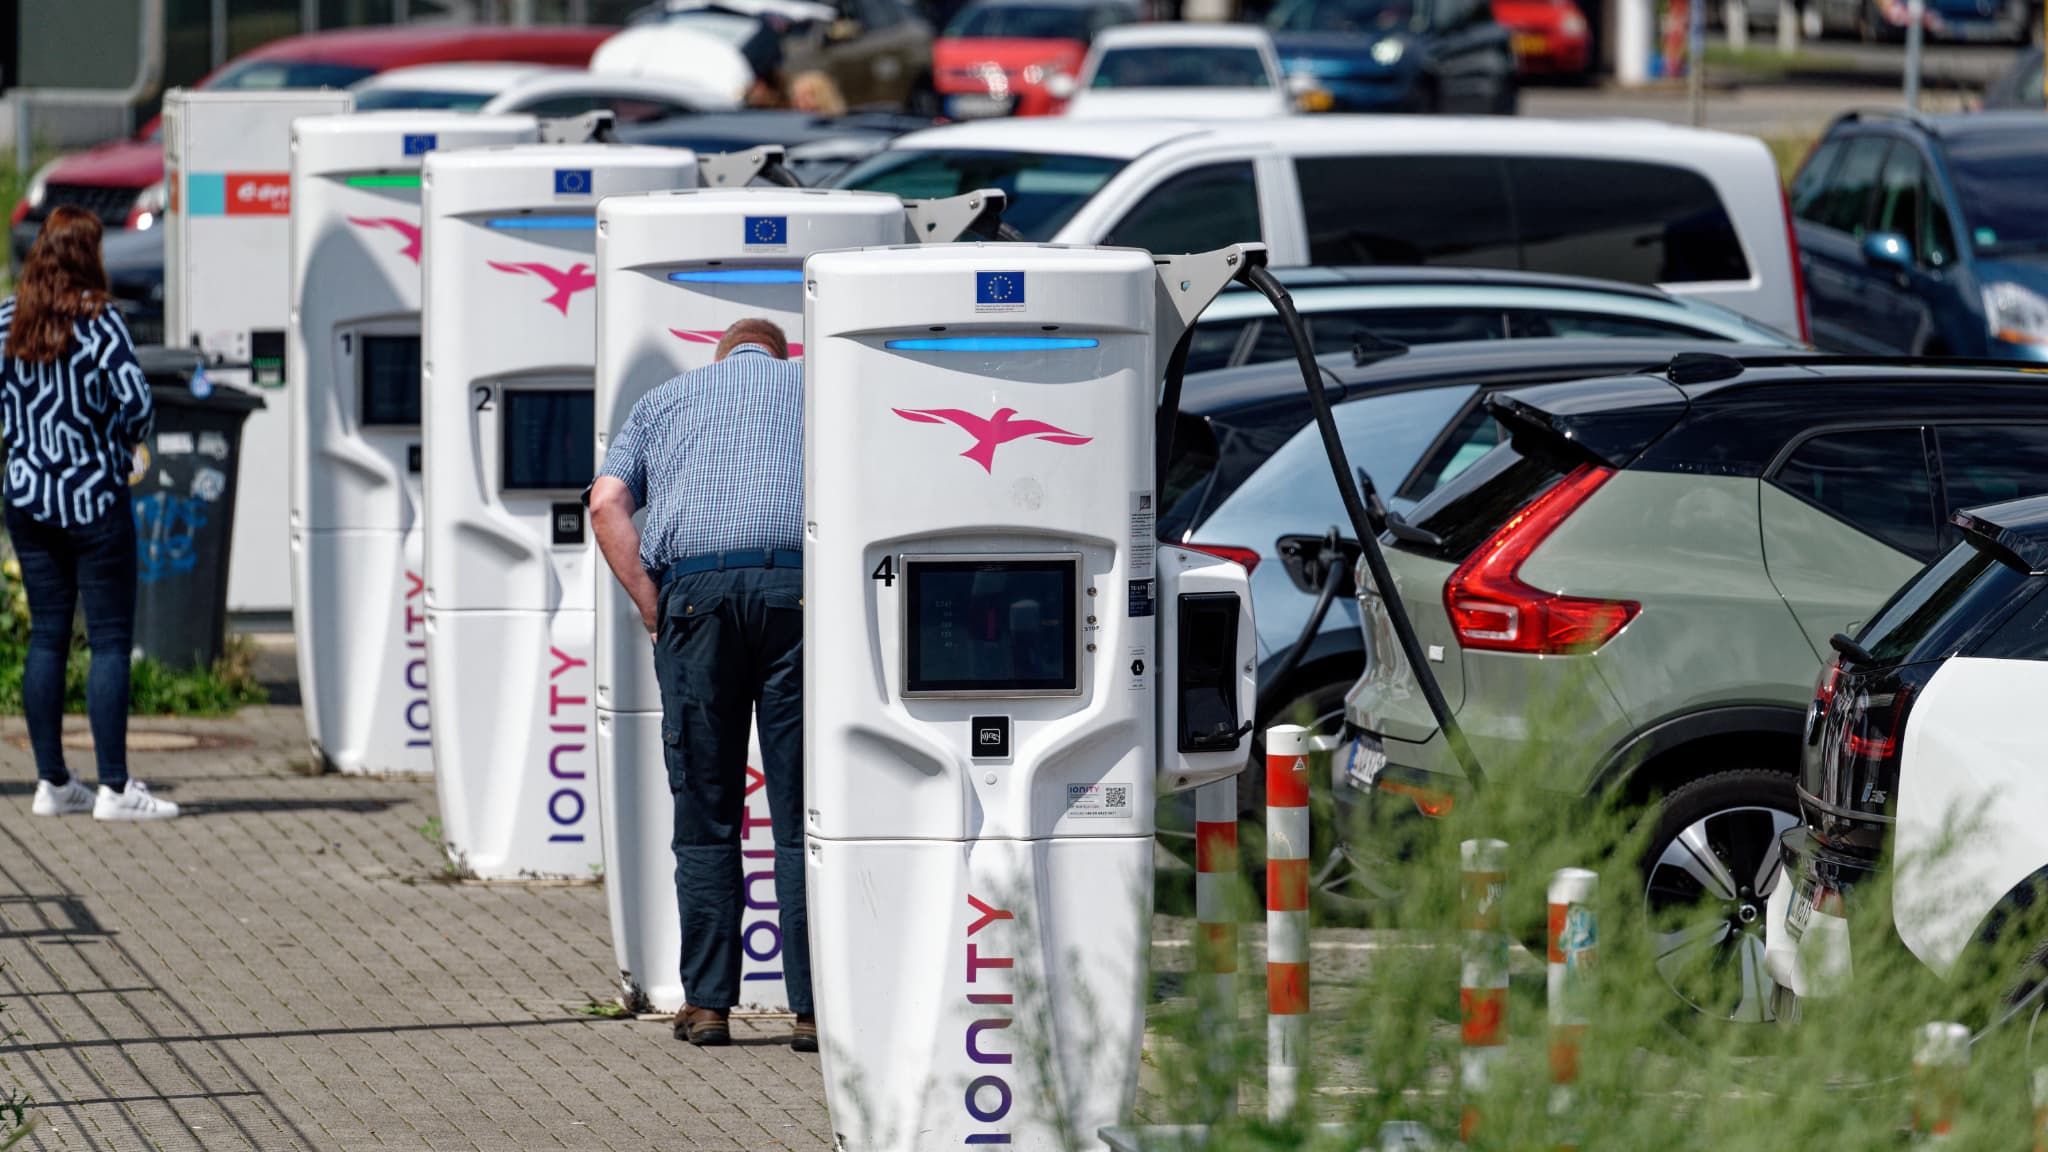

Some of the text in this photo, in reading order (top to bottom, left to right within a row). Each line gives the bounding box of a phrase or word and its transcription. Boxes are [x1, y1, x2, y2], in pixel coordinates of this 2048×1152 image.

[340, 333, 352, 355] 1
[474, 386, 493, 411] 2
[405, 570, 432, 747] IONITY
[872, 555, 896, 587] 4
[549, 646, 588, 843] IONITY
[741, 765, 784, 981] IONITY
[964, 893, 1014, 1145] IONITY
